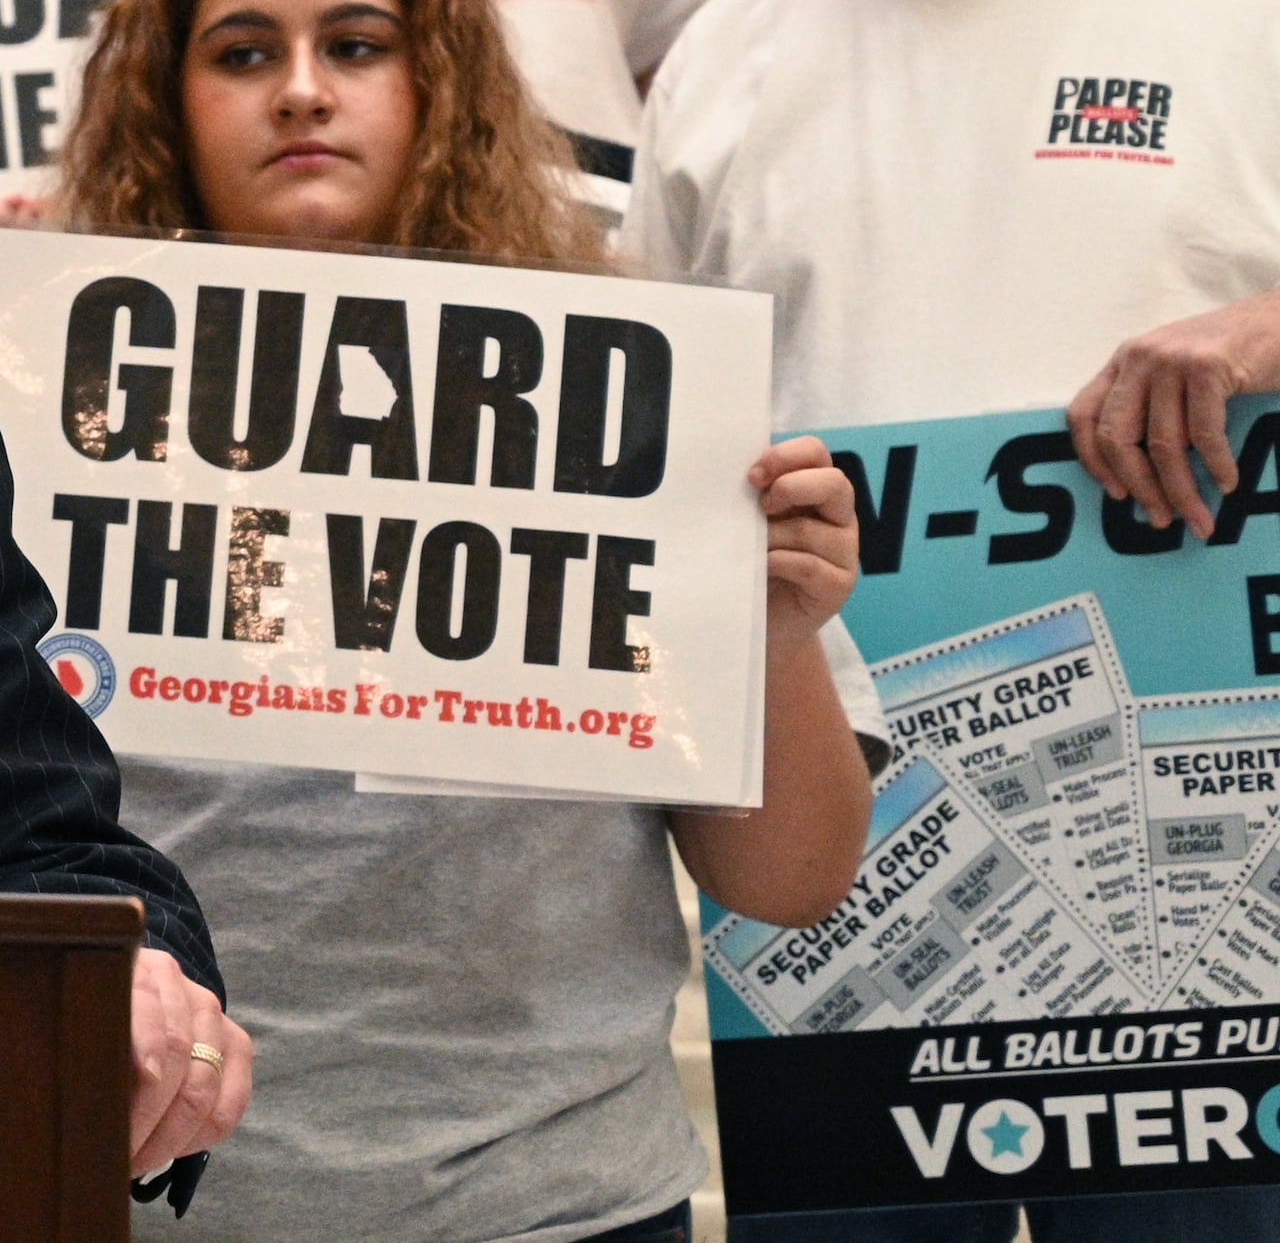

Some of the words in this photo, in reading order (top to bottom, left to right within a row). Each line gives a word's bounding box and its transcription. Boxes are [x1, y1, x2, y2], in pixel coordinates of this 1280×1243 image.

[1054, 77, 1172, 118] PAPER
[1048, 113, 1167, 151] PLEASE
[60, 276, 673, 498] GUARD
[52, 493, 292, 644] THE
[326, 512, 657, 676] VOTE
[993, 657, 1094, 704] GRADE
[968, 688, 1072, 737] BALLOT
[959, 743, 1007, 768] VOTE
[1048, 724, 1112, 754] UN-LEASH
[1053, 746, 1094, 770] TRUST
[1091, 768, 1127, 784] Process
[1182, 772, 1276, 797] PAPER
[876, 800, 960, 878] GRADE
[1166, 822, 1223, 839] UN-PLUG
[1167, 839, 1224, 856] GEORGIA
[946, 854, 999, 904] UN-LEASH
[957, 879, 991, 915] TRUST
[791, 914, 868, 985] PAPER
[864, 834, 952, 918] BALLOT
[870, 912, 913, 951] VOTE
[892, 937, 941, 978] UN-SEAL
[903, 946, 952, 991] BALLOTS
[806, 984, 854, 1030] UN-PLUG
[910, 1036, 991, 1077] ALL
[1004, 1020, 1202, 1070] BALLOTS
